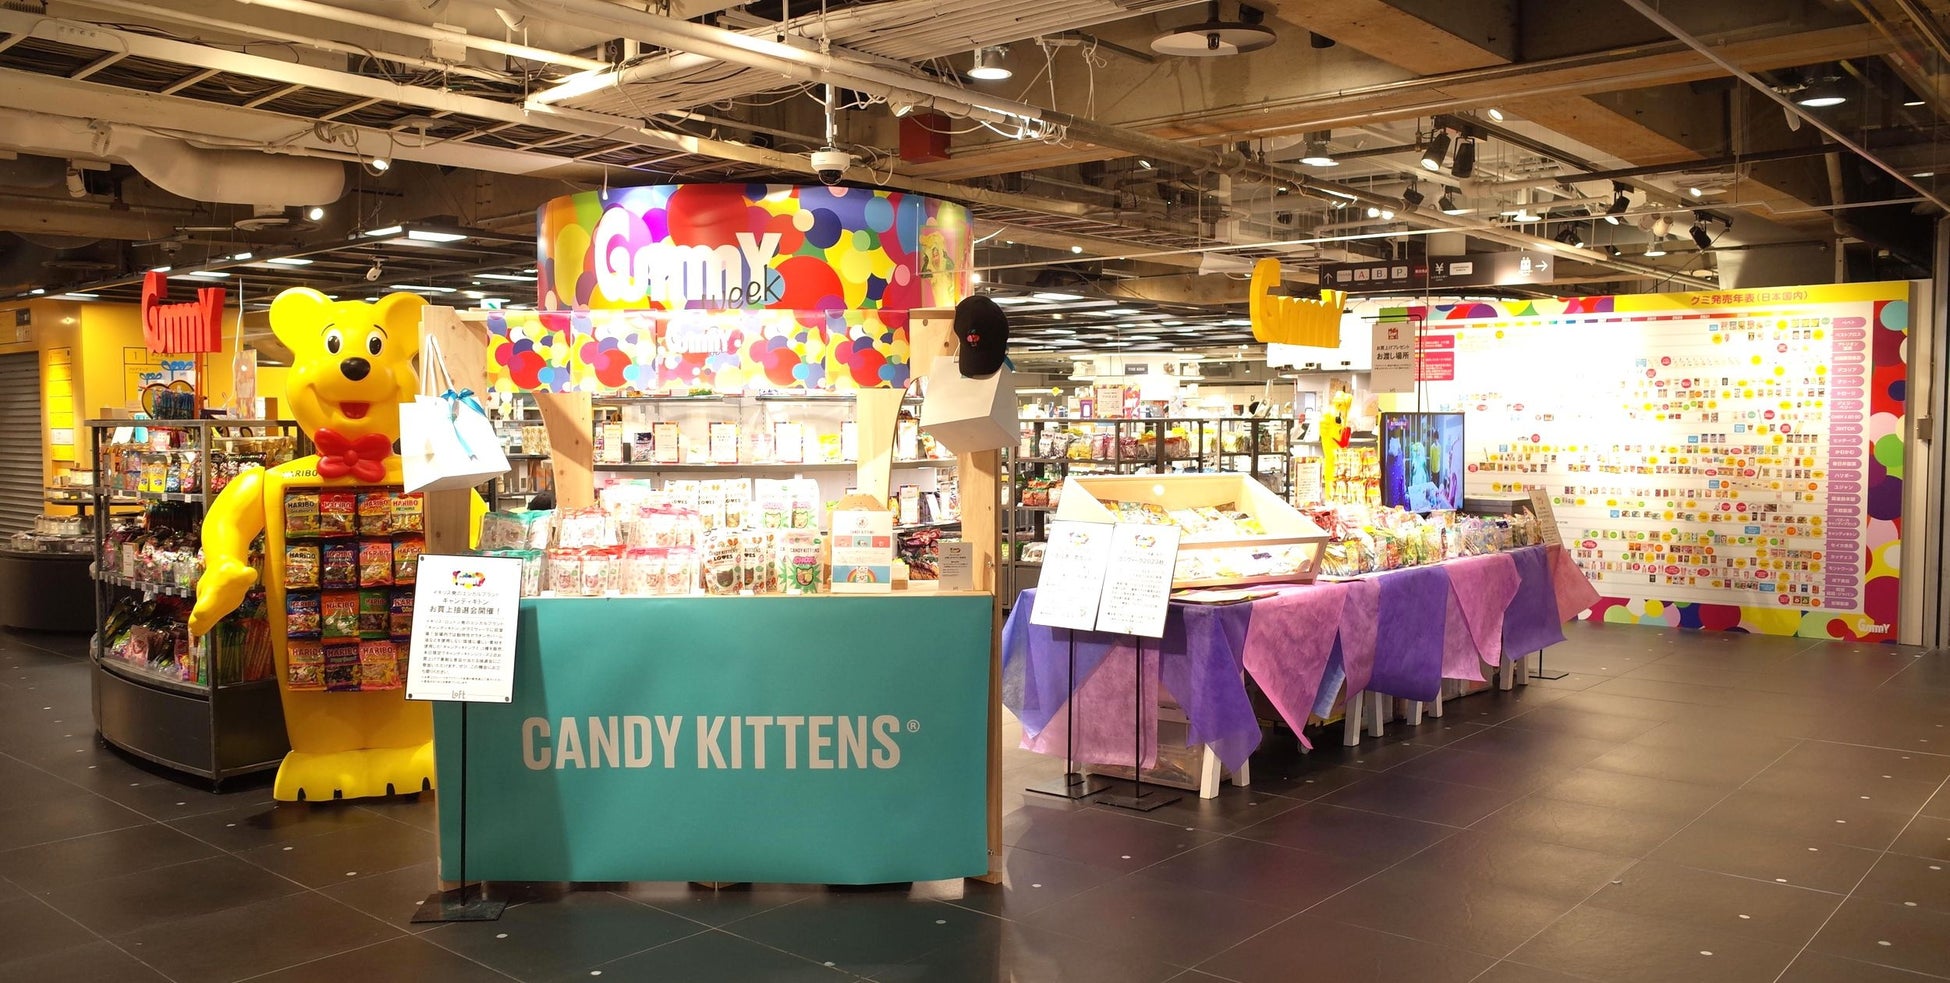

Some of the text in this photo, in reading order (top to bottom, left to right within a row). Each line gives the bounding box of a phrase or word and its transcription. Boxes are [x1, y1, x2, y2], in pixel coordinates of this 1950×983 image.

[1376, 351, 1410, 360] お渡し場所
[522, 715, 683, 770] CANDY
